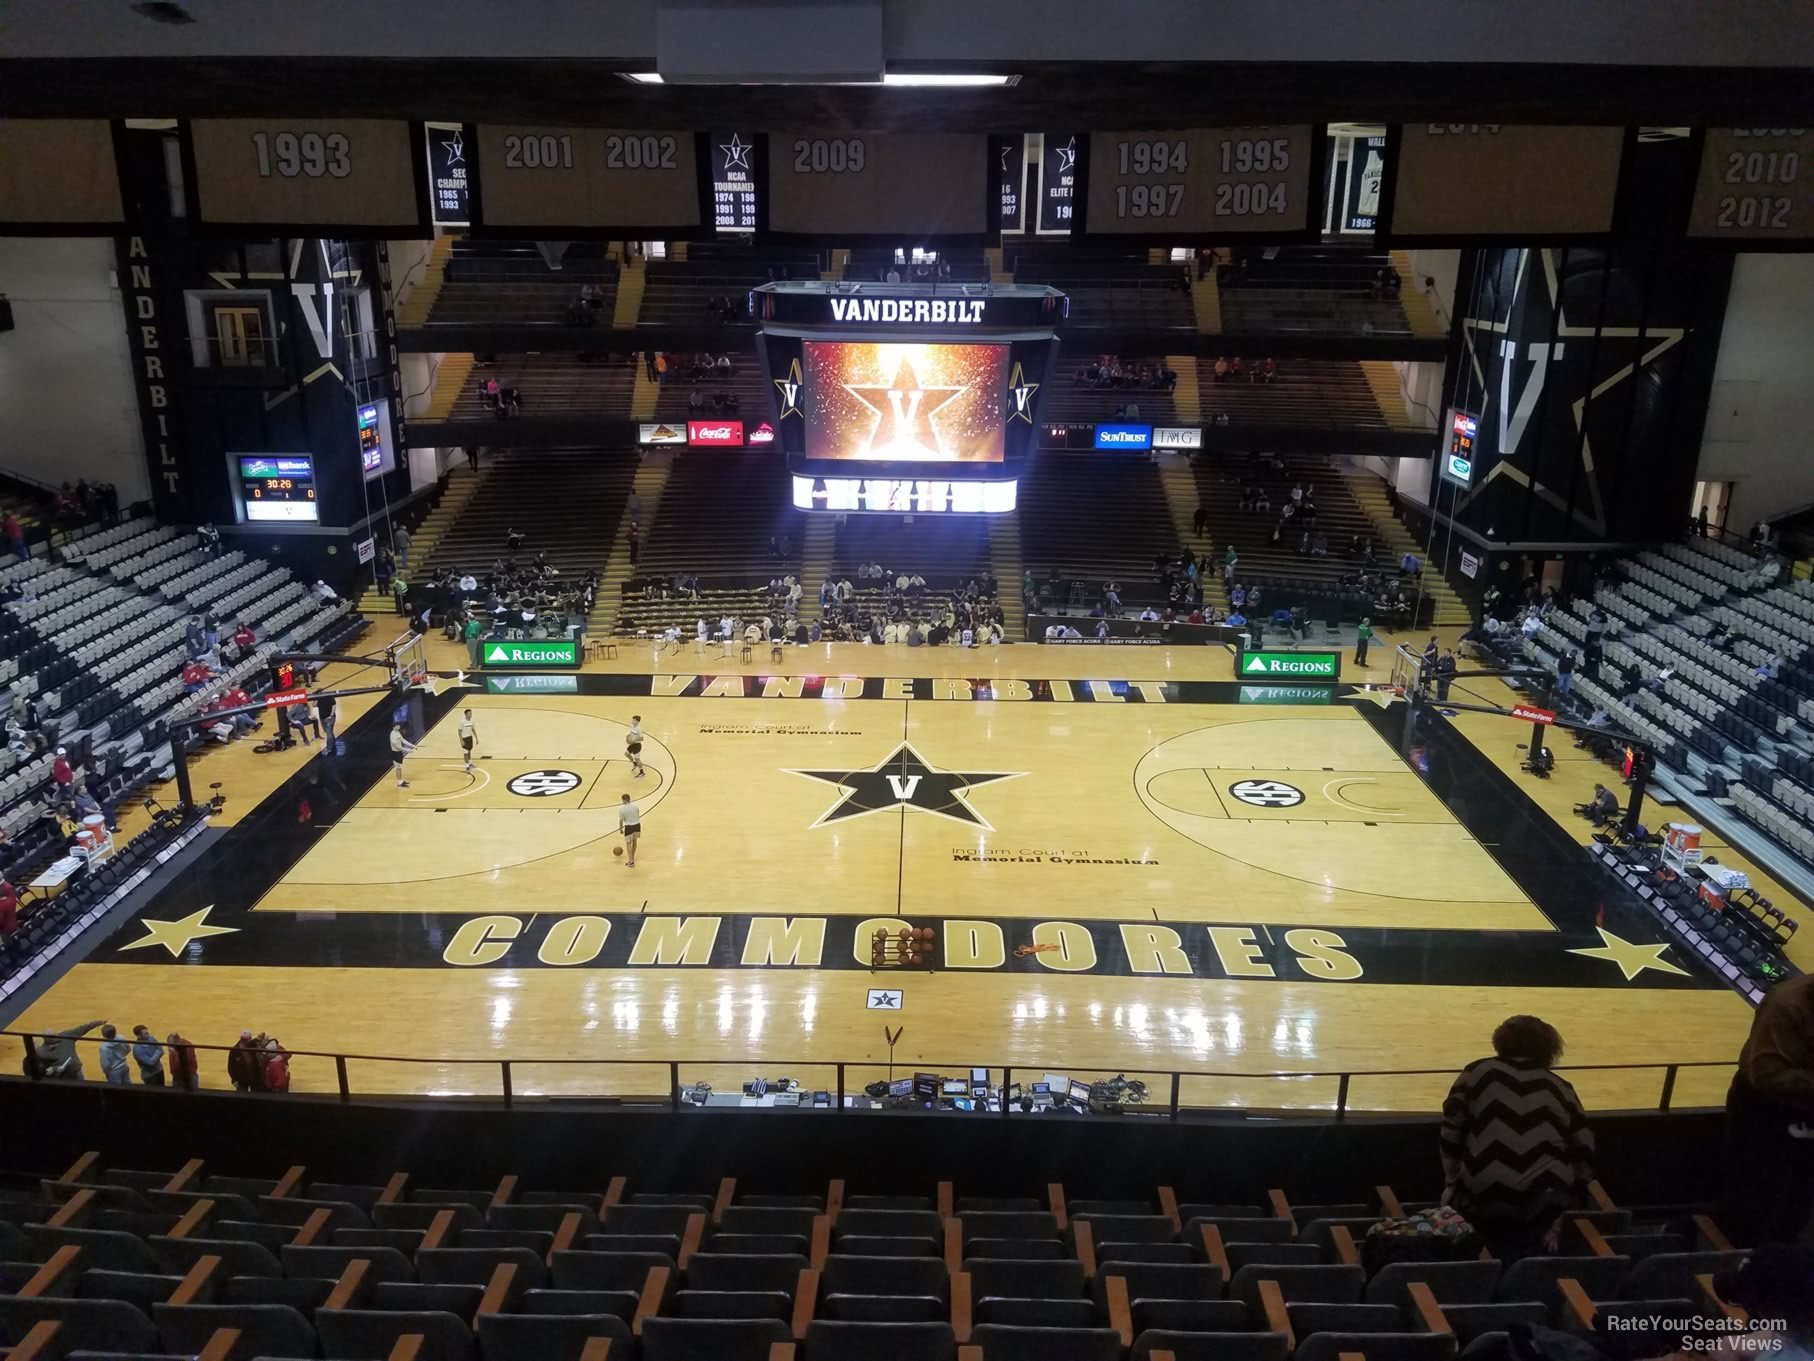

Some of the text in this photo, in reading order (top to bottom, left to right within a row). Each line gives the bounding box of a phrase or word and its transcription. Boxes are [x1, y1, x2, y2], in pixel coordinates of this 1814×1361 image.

[253, 132, 352, 178] 1993
[505, 135, 573, 169] 2001
[606, 135, 678, 169] 2002
[794, 139, 865, 173] 2009
[1117, 141, 1188, 175] 1994
[1221, 139, 1289, 173] 1995
[727, 171, 747, 182] NCAA
[1724, 152, 1799, 184] 2010
[438, 189, 458, 200] 1965
[715, 192, 734, 203] 1974
[1050, 187, 1069, 198] ELITE
[1116, 184, 1185, 219] 1997
[1215, 182, 1288, 217] 2004
[440, 200, 459, 210] 1993
[715, 204, 734, 214] 1991
[1717, 197, 1792, 229] 2012
[715, 215, 735, 226] 2008
[830, 298, 986, 323] VANDERBILT
[129, 236, 180, 494] ANDERBILT
[785, 384, 798, 407] V
[1015, 388, 1029, 411] V
[887, 391, 923, 436] V
[1160, 431, 1193, 444] IMG
[254, 489, 261, 498] 0
[307, 489, 314, 498] 0
[651, 675, 1168, 703] VANDERBILT
[886, 775, 923, 799] V
[952, 847, 1089, 857] Ingram Court at
[953, 855, 1160, 866] Memorial Gymnasium
[442, 914, 1364, 981] COMMODORES
